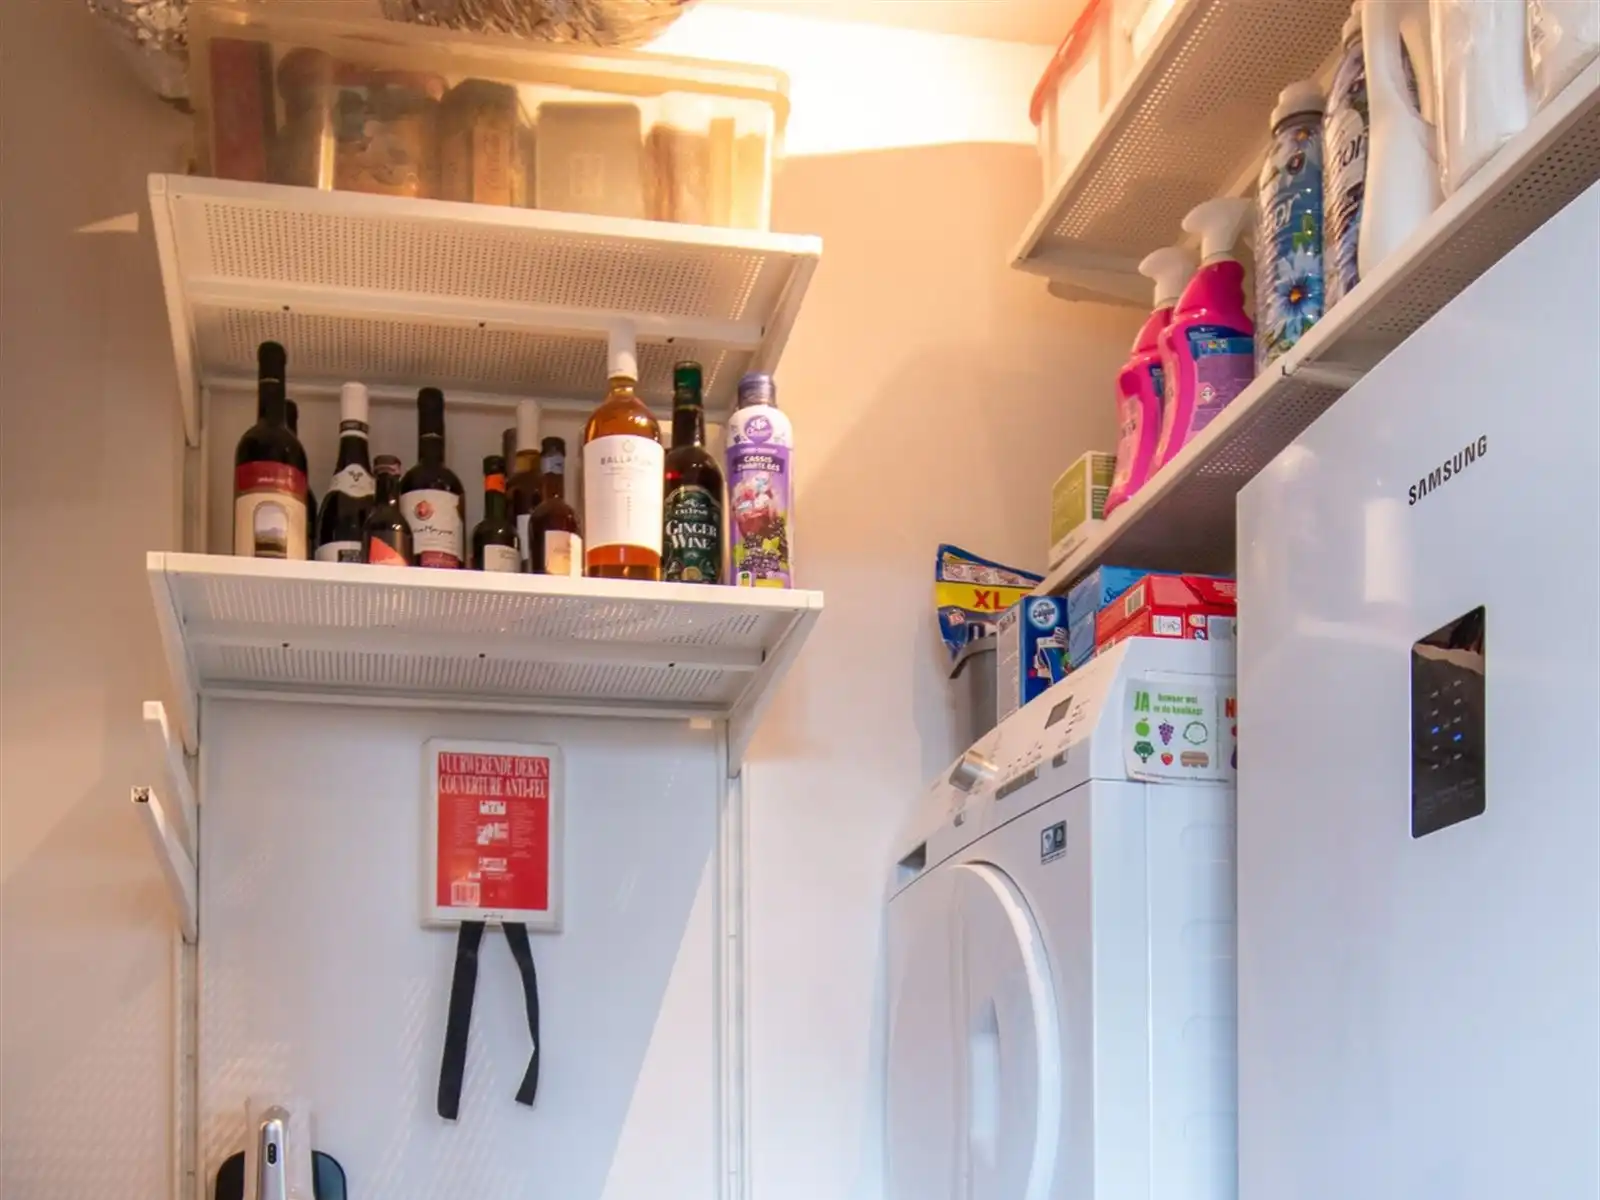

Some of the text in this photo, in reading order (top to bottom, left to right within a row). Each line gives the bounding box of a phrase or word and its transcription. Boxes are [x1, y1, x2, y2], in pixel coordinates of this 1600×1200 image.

[1408, 434, 1487, 506] SAMSUNG
[666, 519, 717, 538] GINGER
[671, 534, 712, 549] WINE
[973, 589, 1009, 611] XL
[1134, 691, 1150, 712] JA
[515, 757, 548, 778] DEKEN
[440, 775, 503, 797] COUVERTURE
